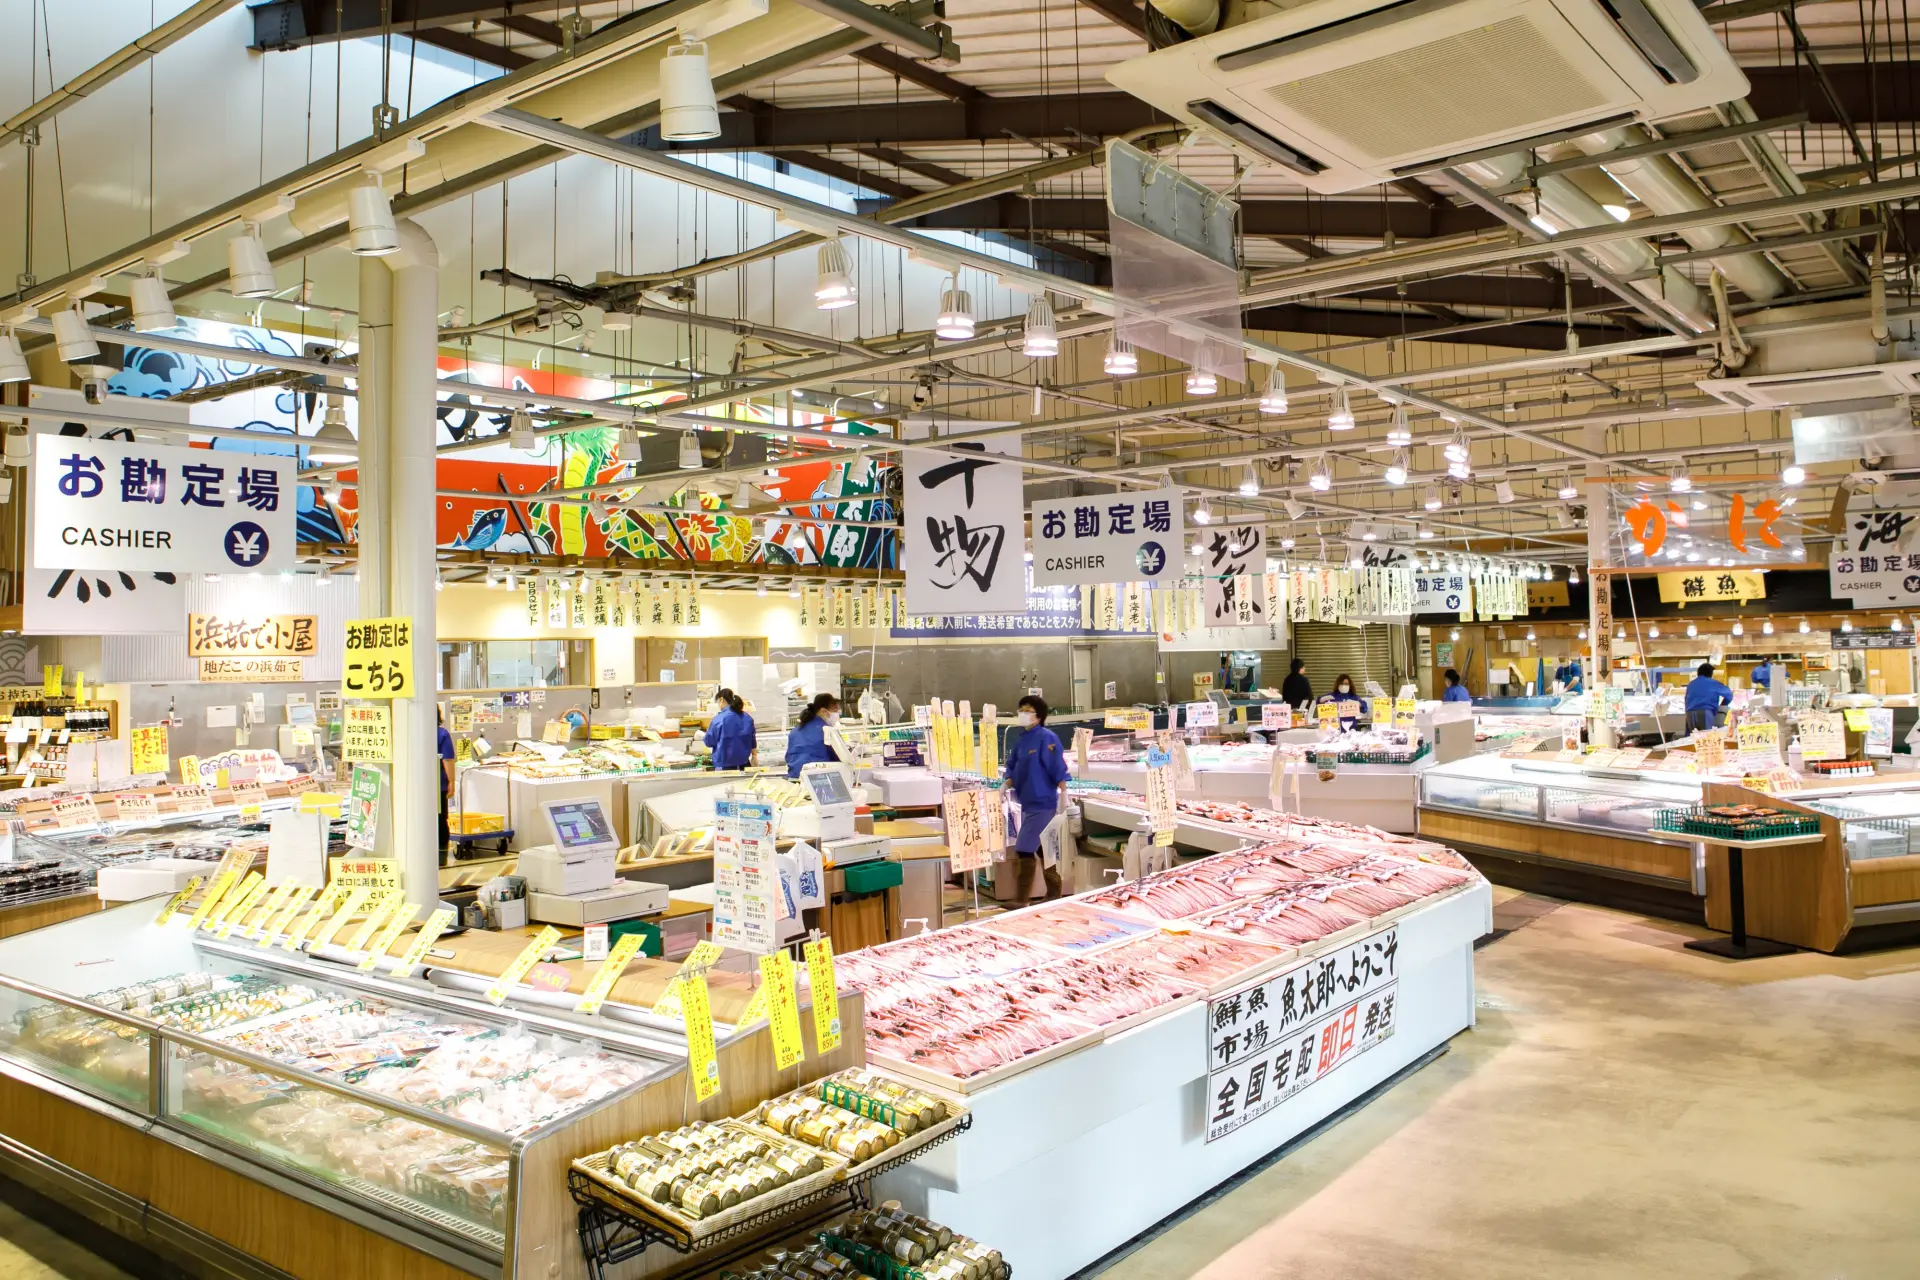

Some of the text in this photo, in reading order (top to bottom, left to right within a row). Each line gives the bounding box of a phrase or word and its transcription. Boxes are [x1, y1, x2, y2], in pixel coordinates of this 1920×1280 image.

[58, 453, 280, 512] お勘定場
[1042, 500, 1171, 539] お勘定場
[61, 526, 172, 549] CASHIER
[1045, 555, 1105, 571] CASHIER
[1415, 576, 1464, 592] 勘定場
[1682, 573, 1740, 598] 鮮魚
[1840, 581, 1882, 591] CASHIER
[195, 615, 313, 652] 浜茹で小屋
[346, 623, 409, 649] お勘定は
[346, 660, 404, 691] こちら
[1801, 722, 1834, 735] ちりめん
[341, 862, 389, 874] 氷(無料)を
[336, 877, 395, 888] 出口に用意して
[1279, 930, 1399, 1032] 魚太郎へようこそ
[1212, 987, 1269, 1033] 鮮魚
[1213, 1020, 1270, 1063] 市場
